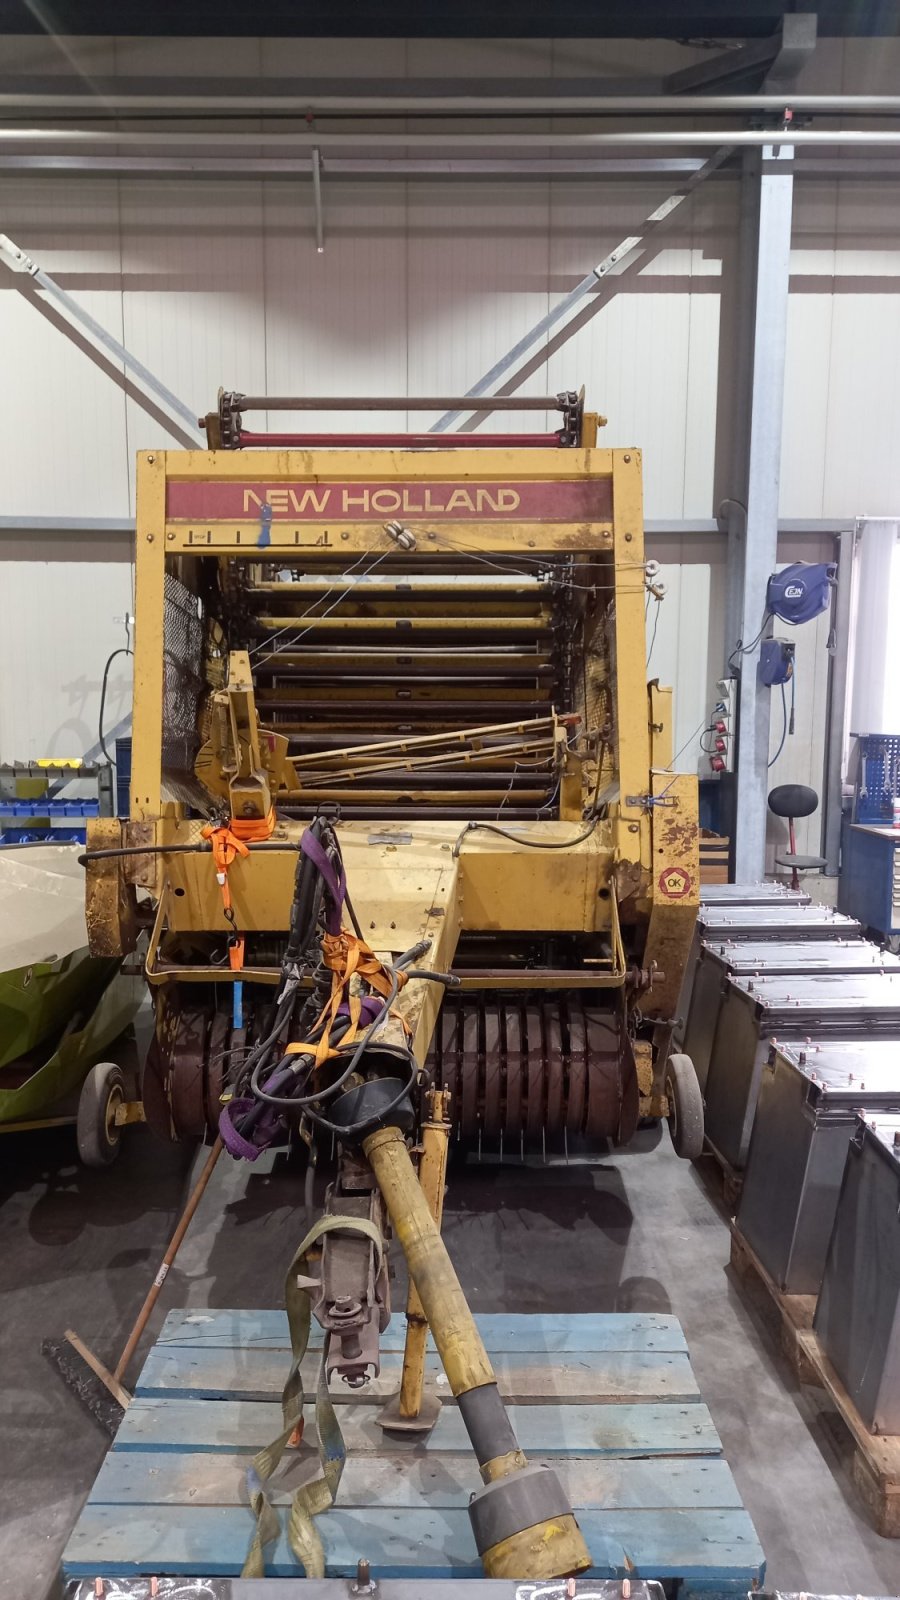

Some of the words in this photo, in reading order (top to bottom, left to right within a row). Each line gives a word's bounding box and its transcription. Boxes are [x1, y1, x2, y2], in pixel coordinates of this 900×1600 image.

[243, 489, 331, 512] NEW
[342, 489, 521, 512] HOLLAND
[668, 878, 682, 887] OK
